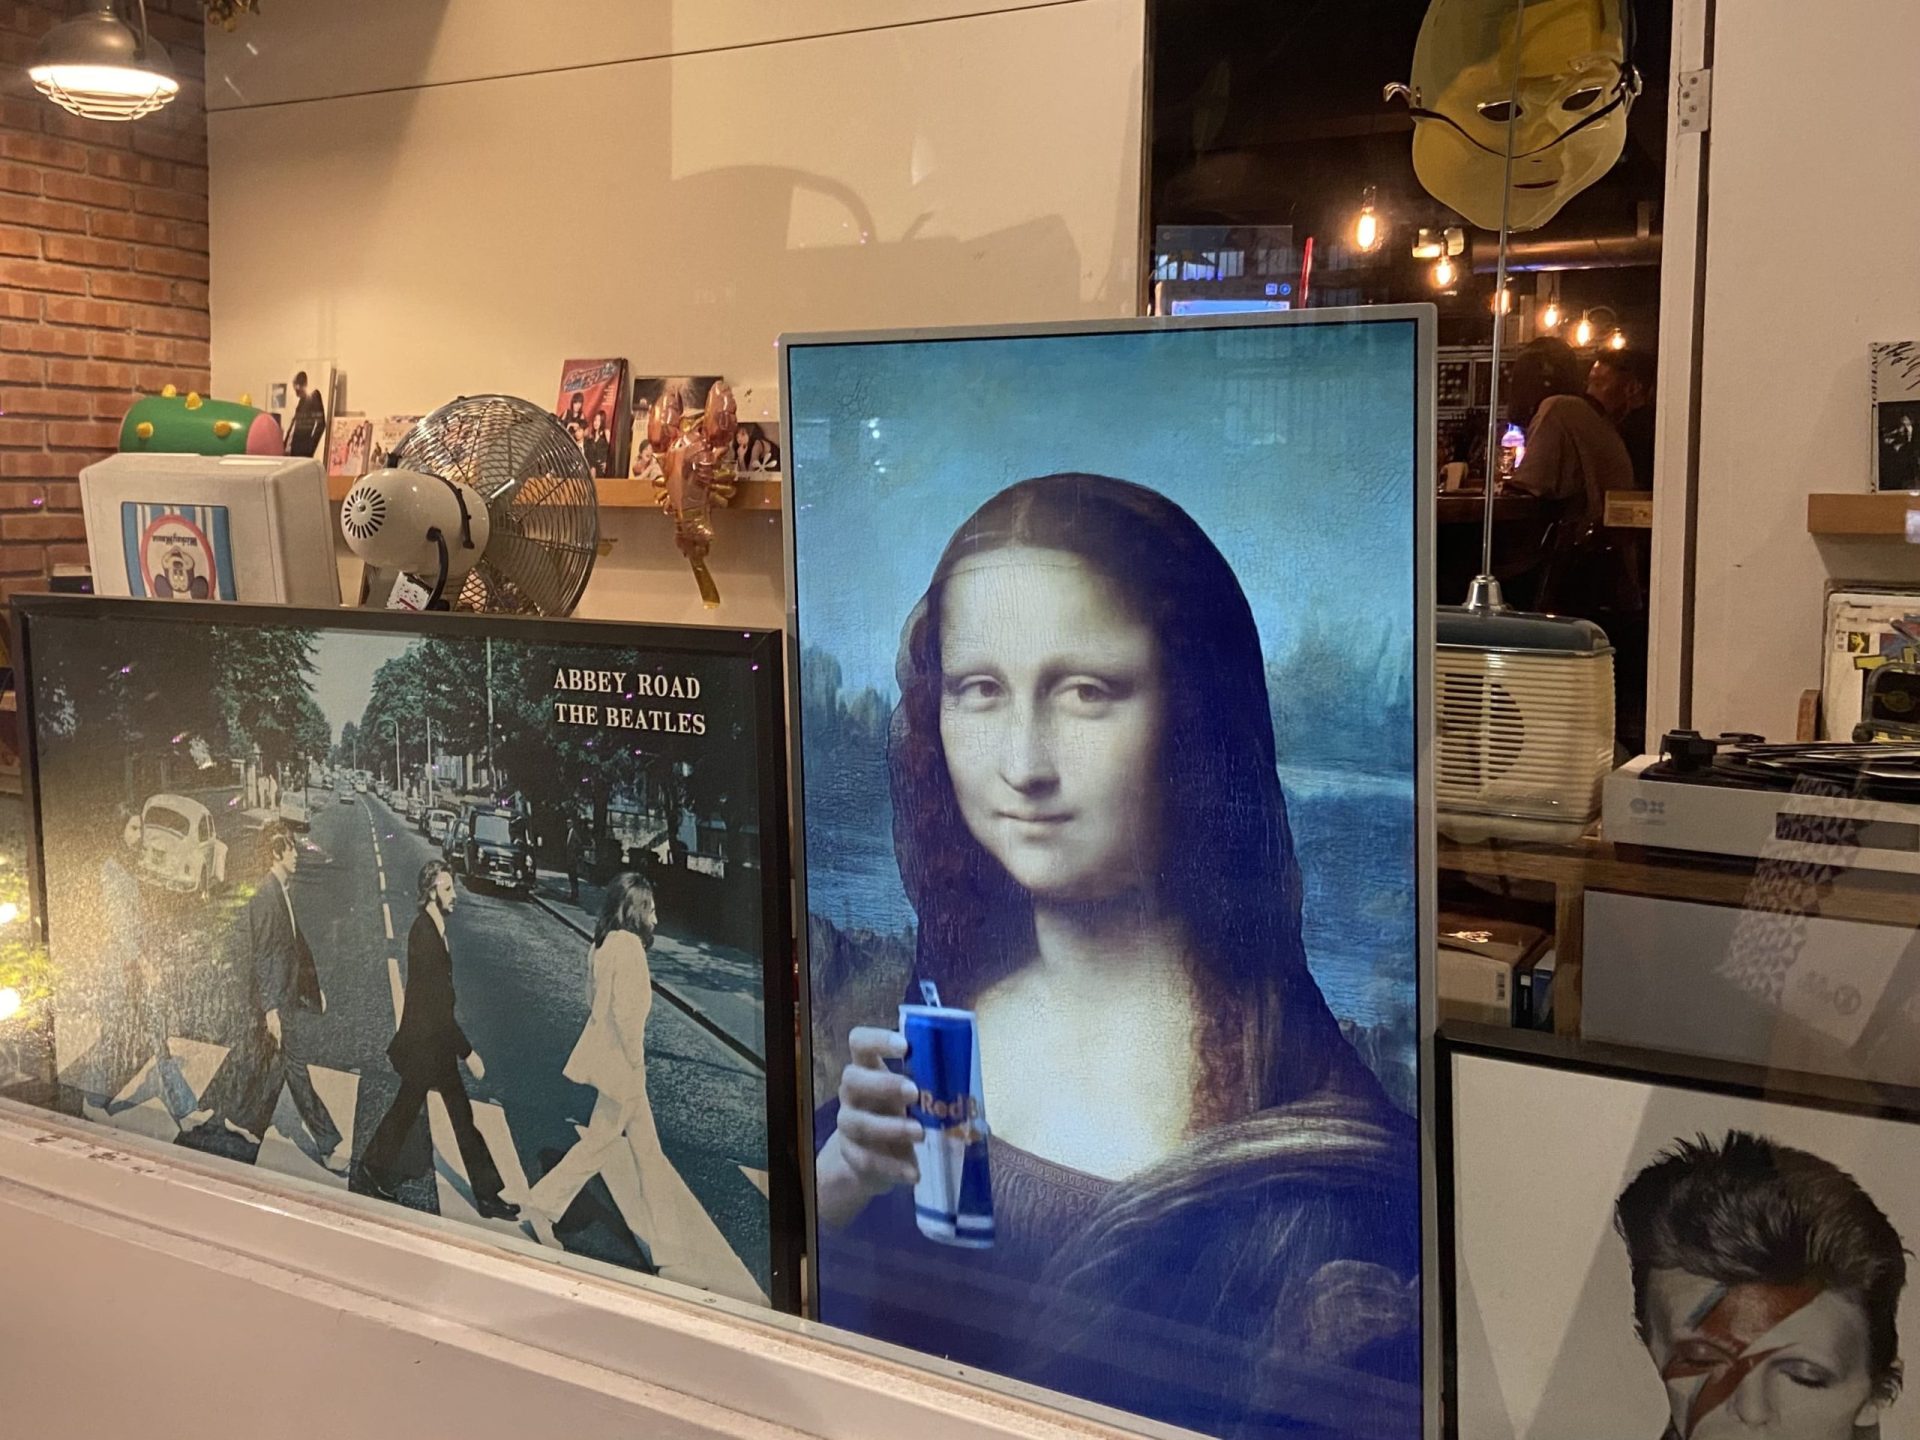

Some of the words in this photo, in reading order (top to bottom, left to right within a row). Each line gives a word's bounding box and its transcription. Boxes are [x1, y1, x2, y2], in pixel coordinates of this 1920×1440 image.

[553, 667, 627, 694] ABBEY
[637, 673, 701, 700] ROAD
[554, 702, 599, 726] THE
[605, 706, 706, 736] BEATLES
[920, 1090, 964, 1120] Red
